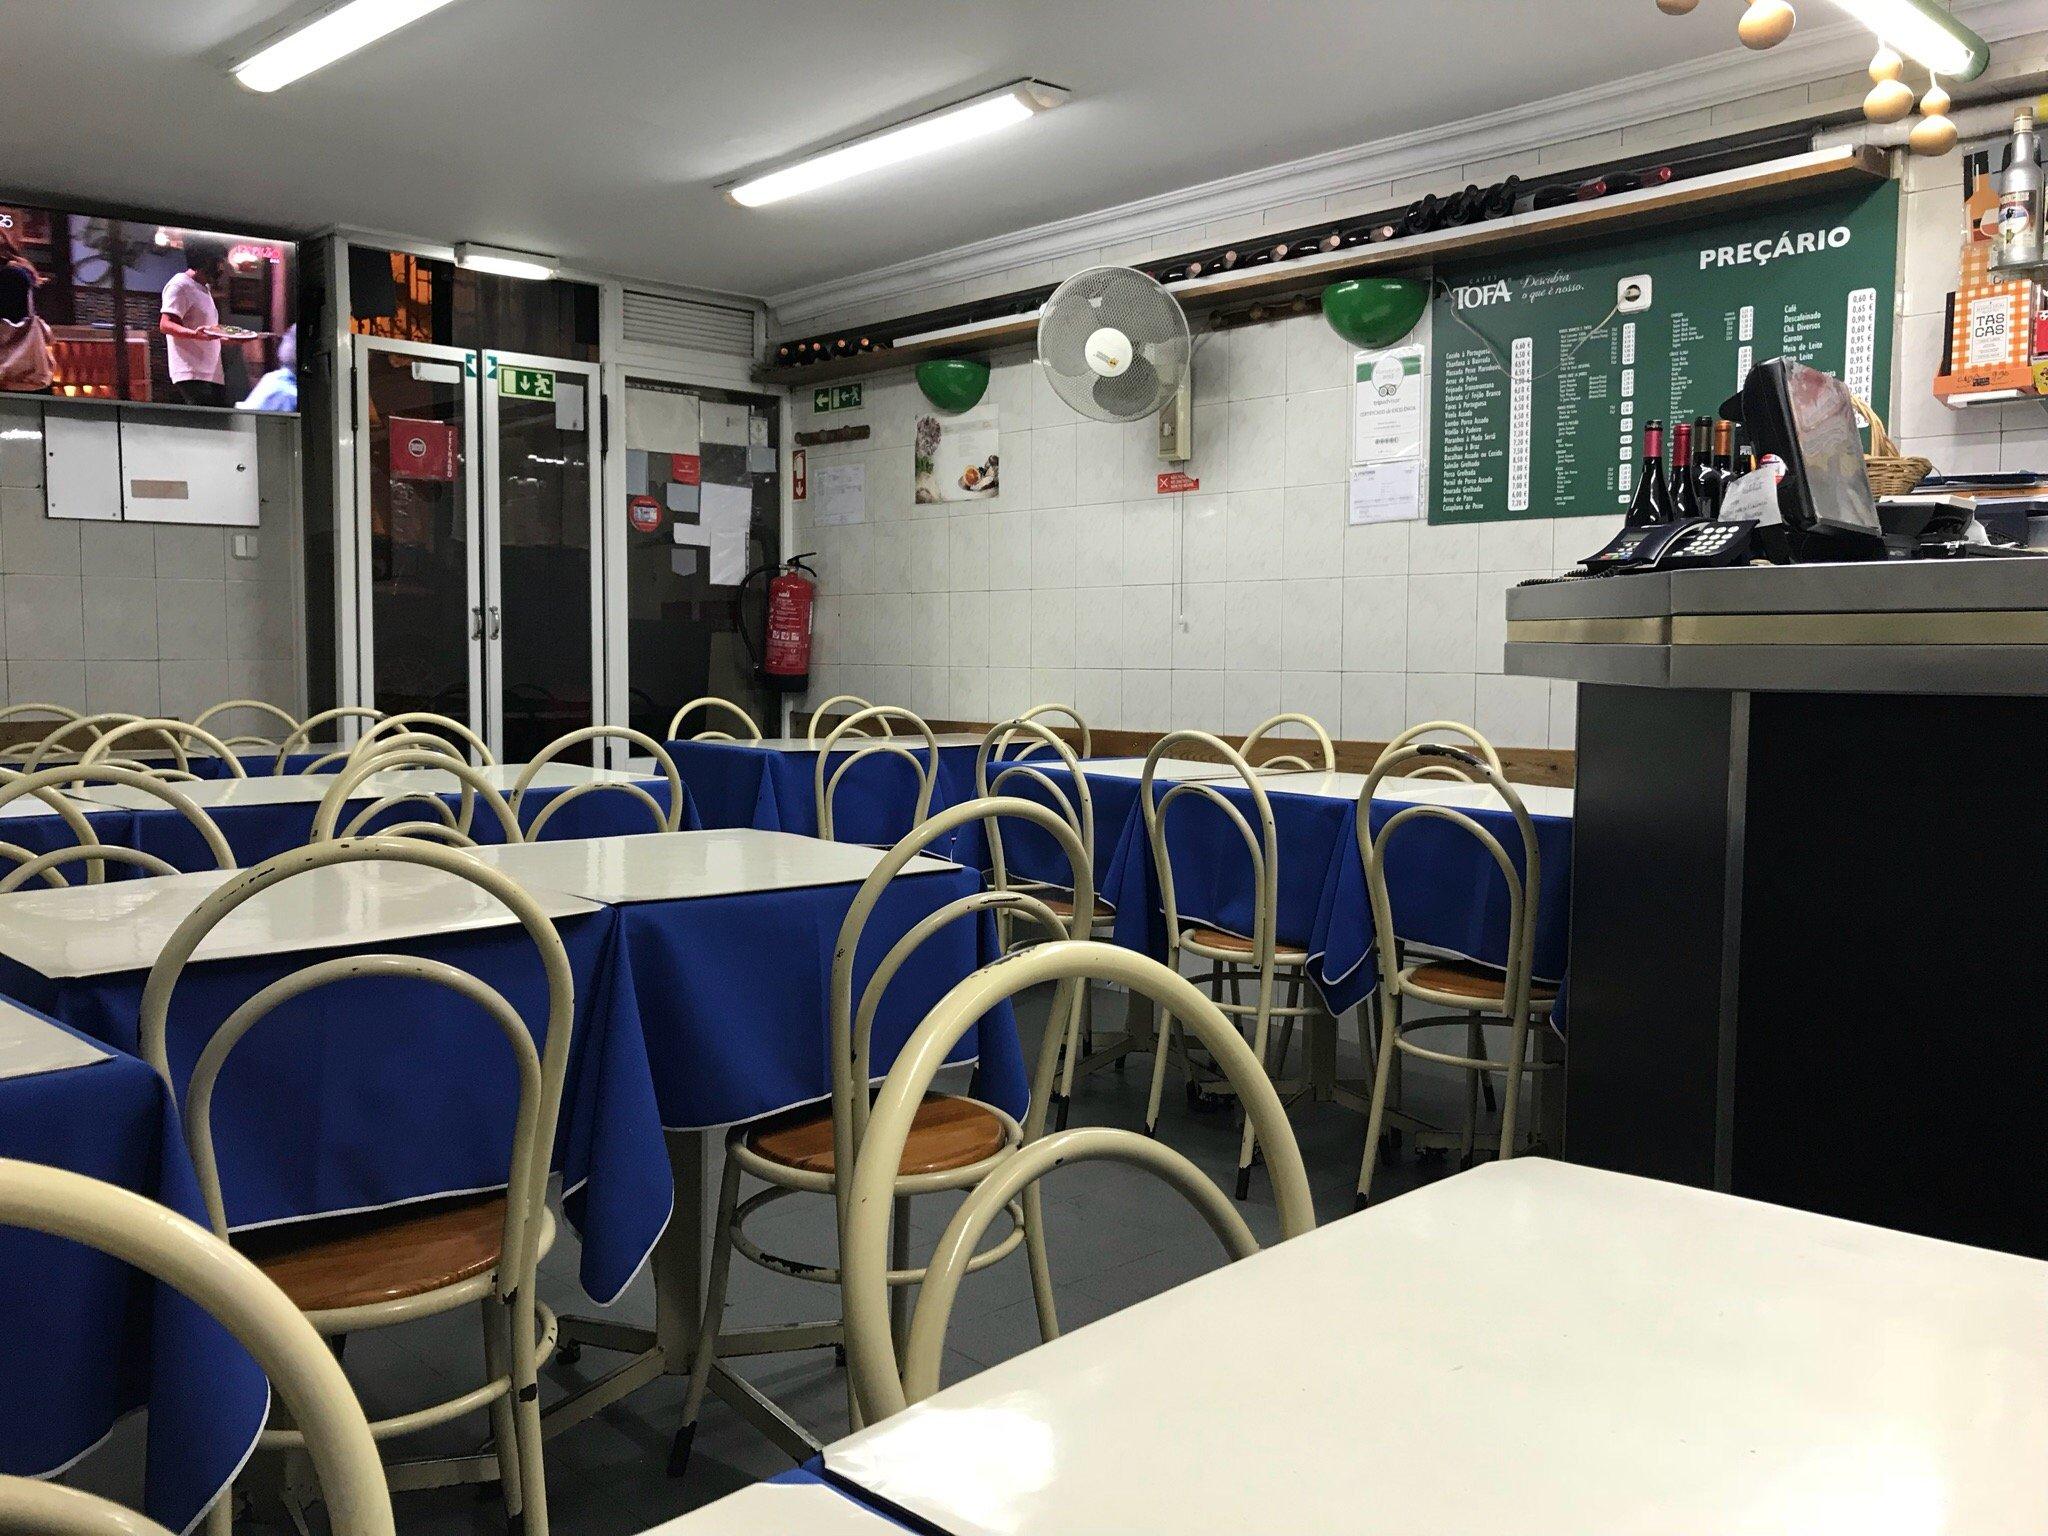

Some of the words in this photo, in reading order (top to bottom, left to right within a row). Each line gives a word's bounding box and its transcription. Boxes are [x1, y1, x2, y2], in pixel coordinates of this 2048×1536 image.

[1700, 227, 1850, 270] PREÇÁRIO
[1452, 280, 1513, 309] TOFA
[1530, 291, 1545, 303] que
[1784, 304, 1796, 313] Café
[1784, 311, 1821, 323] Descafeinado
[1976, 313, 2004, 326] TAS
[1797, 322, 1820, 330] Diversos
[1975, 325, 2004, 338] CAS
[1809, 342, 1822, 350] Leite
